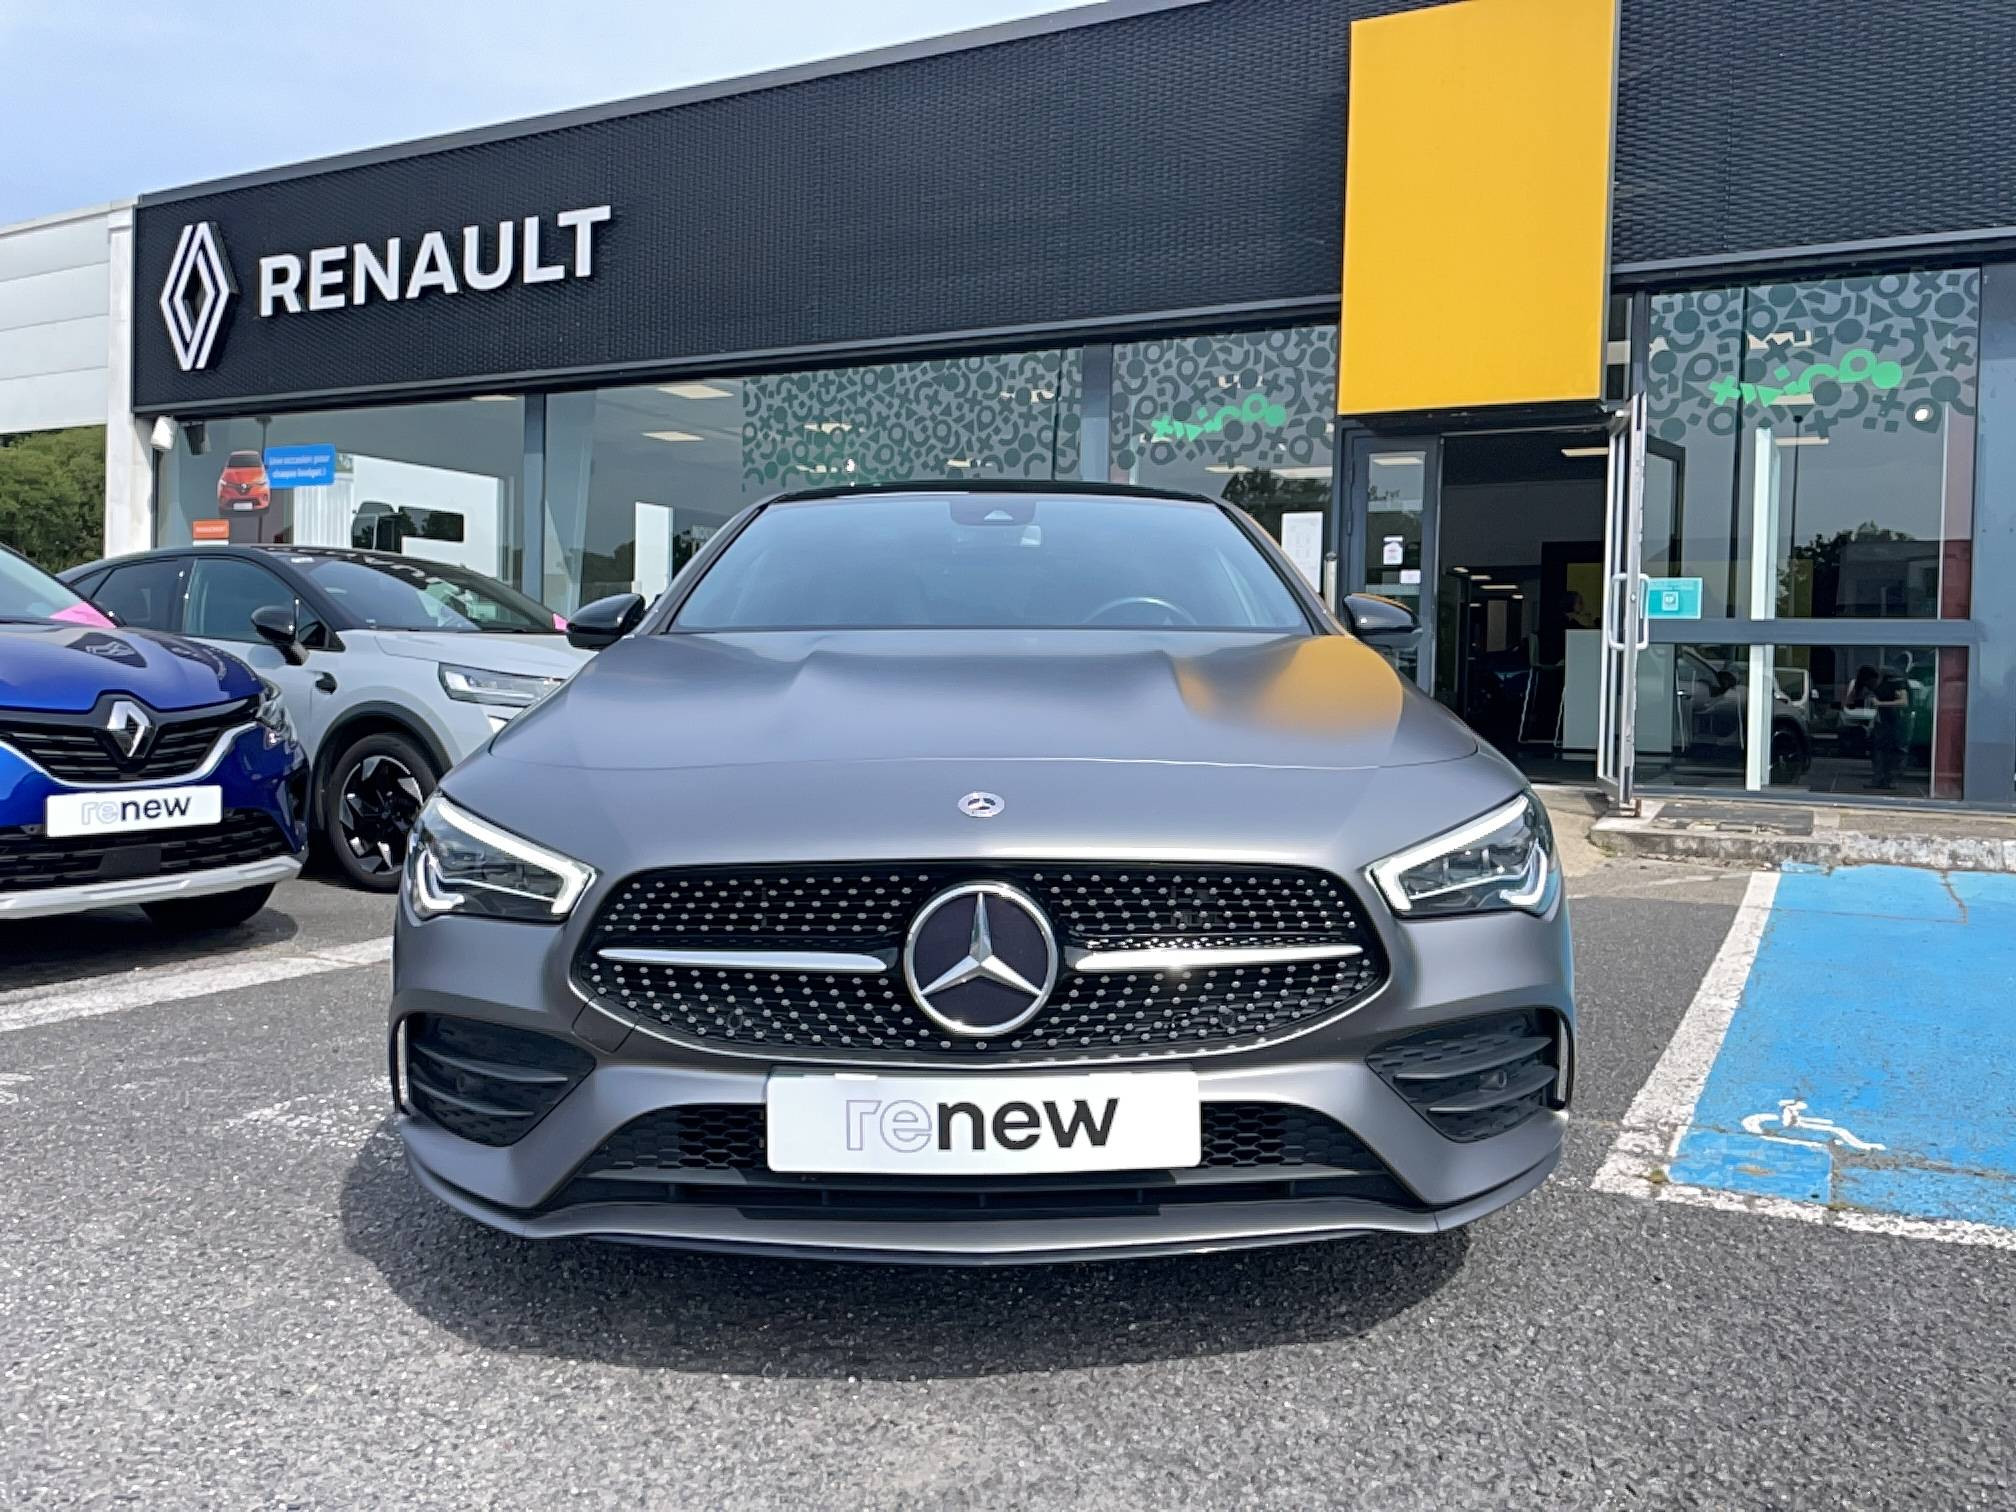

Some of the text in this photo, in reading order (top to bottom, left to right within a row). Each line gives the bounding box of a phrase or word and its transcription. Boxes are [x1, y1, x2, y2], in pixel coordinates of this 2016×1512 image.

[259, 205, 612, 317] RENAULT
[81, 796, 192, 826] renew
[846, 1097, 1120, 1153] renew
